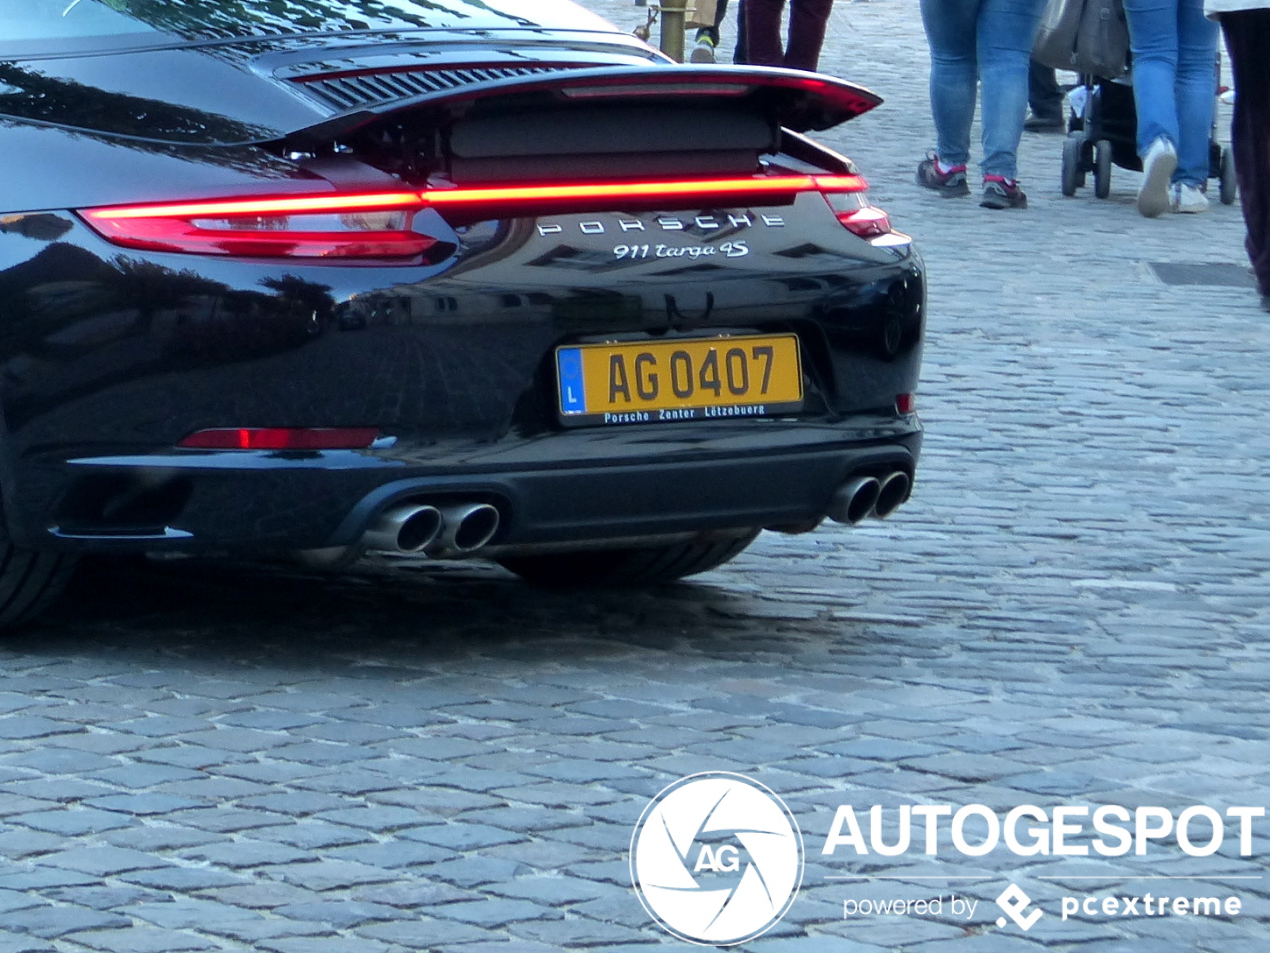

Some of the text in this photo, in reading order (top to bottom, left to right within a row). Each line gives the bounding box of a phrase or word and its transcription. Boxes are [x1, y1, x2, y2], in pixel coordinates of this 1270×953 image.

[536, 213, 786, 237] PORSCHE
[613, 240, 749, 260] 911 targa 4S
[567, 386, 577, 404] L
[604, 410, 650, 424] Porsche
